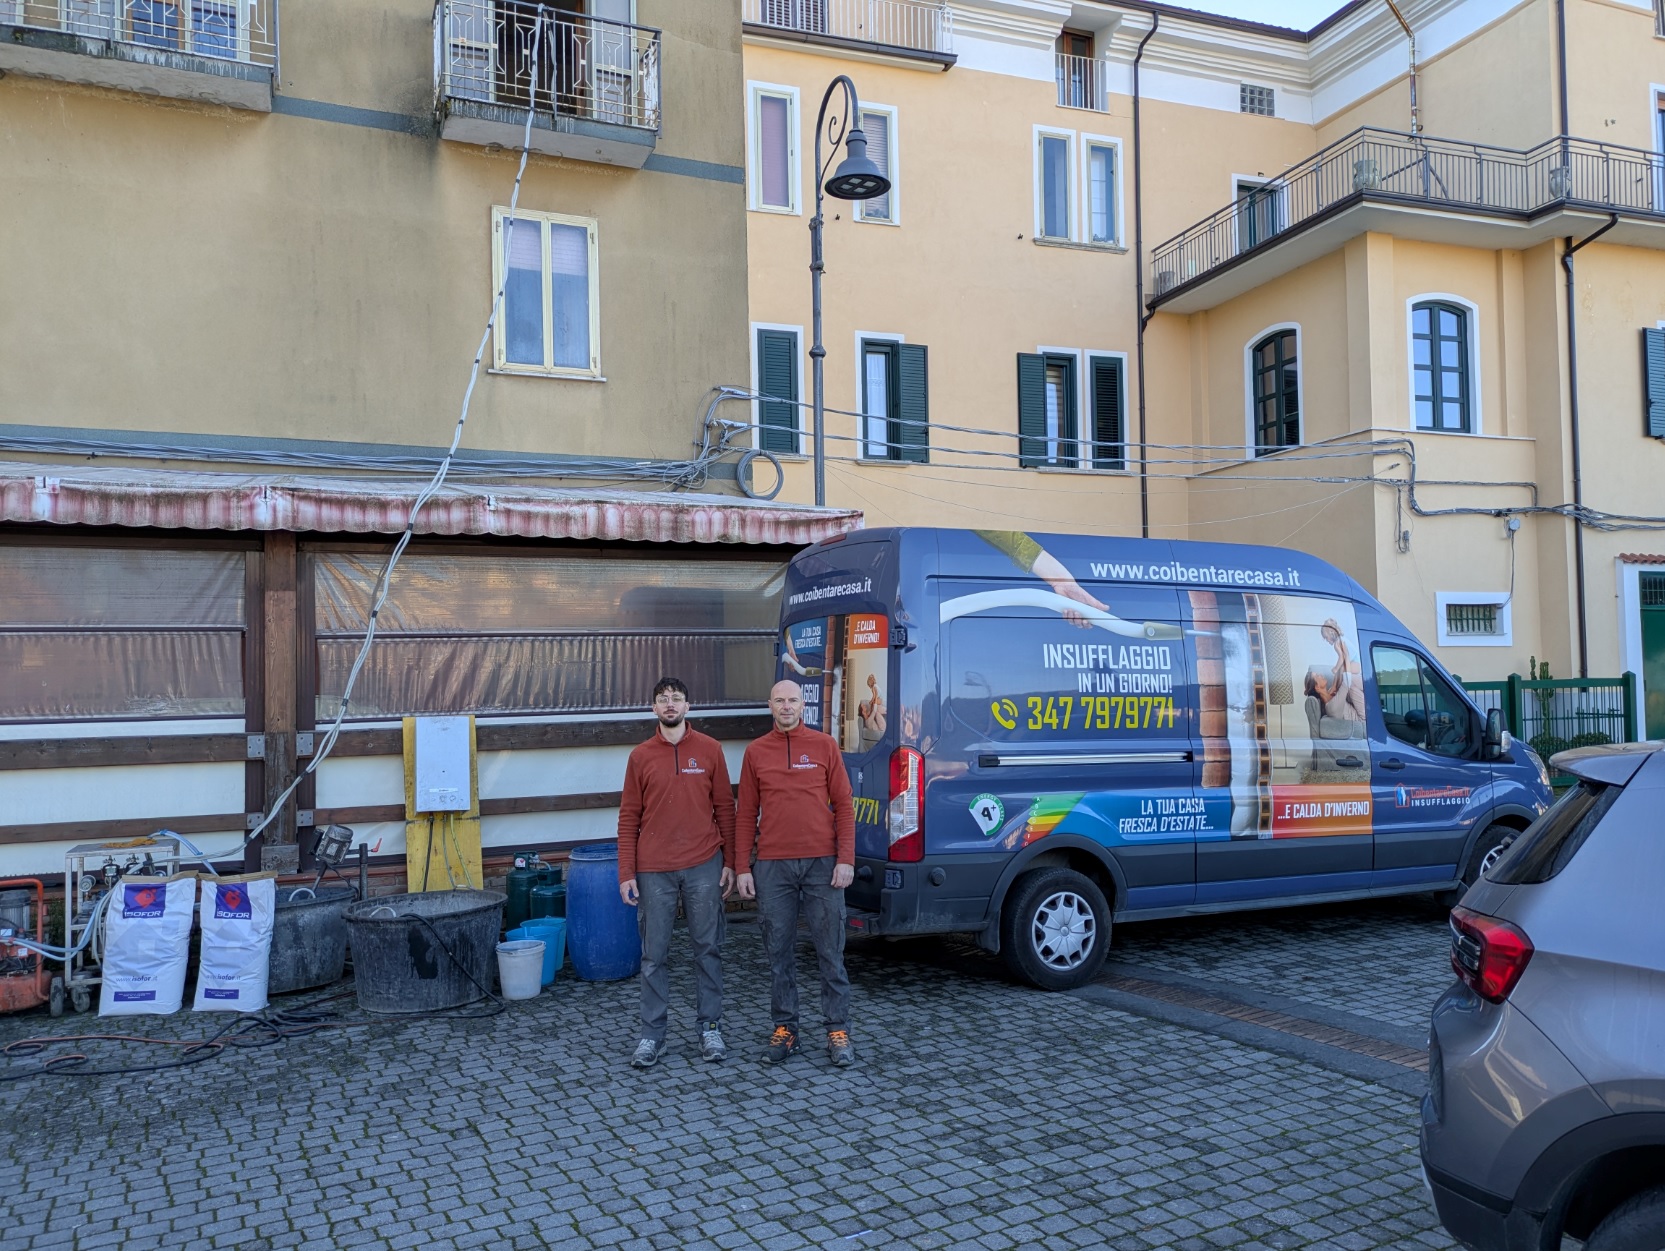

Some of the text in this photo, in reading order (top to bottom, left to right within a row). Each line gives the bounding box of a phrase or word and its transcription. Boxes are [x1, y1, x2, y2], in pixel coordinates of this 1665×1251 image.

[1089, 561, 1301, 587] www.coibentarecasa.it
[788, 576, 872, 606] www.coibentarecasa.it
[1042, 643, 1172, 670] INSUFFLAGGIO
[1077, 672, 1173, 694] IN UN GIORNO!
[1027, 696, 1174, 730] 347 7979771
[1141, 798, 1206, 815] LA TUA CASA
[1293, 803, 1322, 819] CALDA
[1324, 801, 1370, 817] D'INVERNO
[1411, 797, 1471, 807] INSUFFLAGGIO
[1119, 817, 1158, 833] FRESCA
